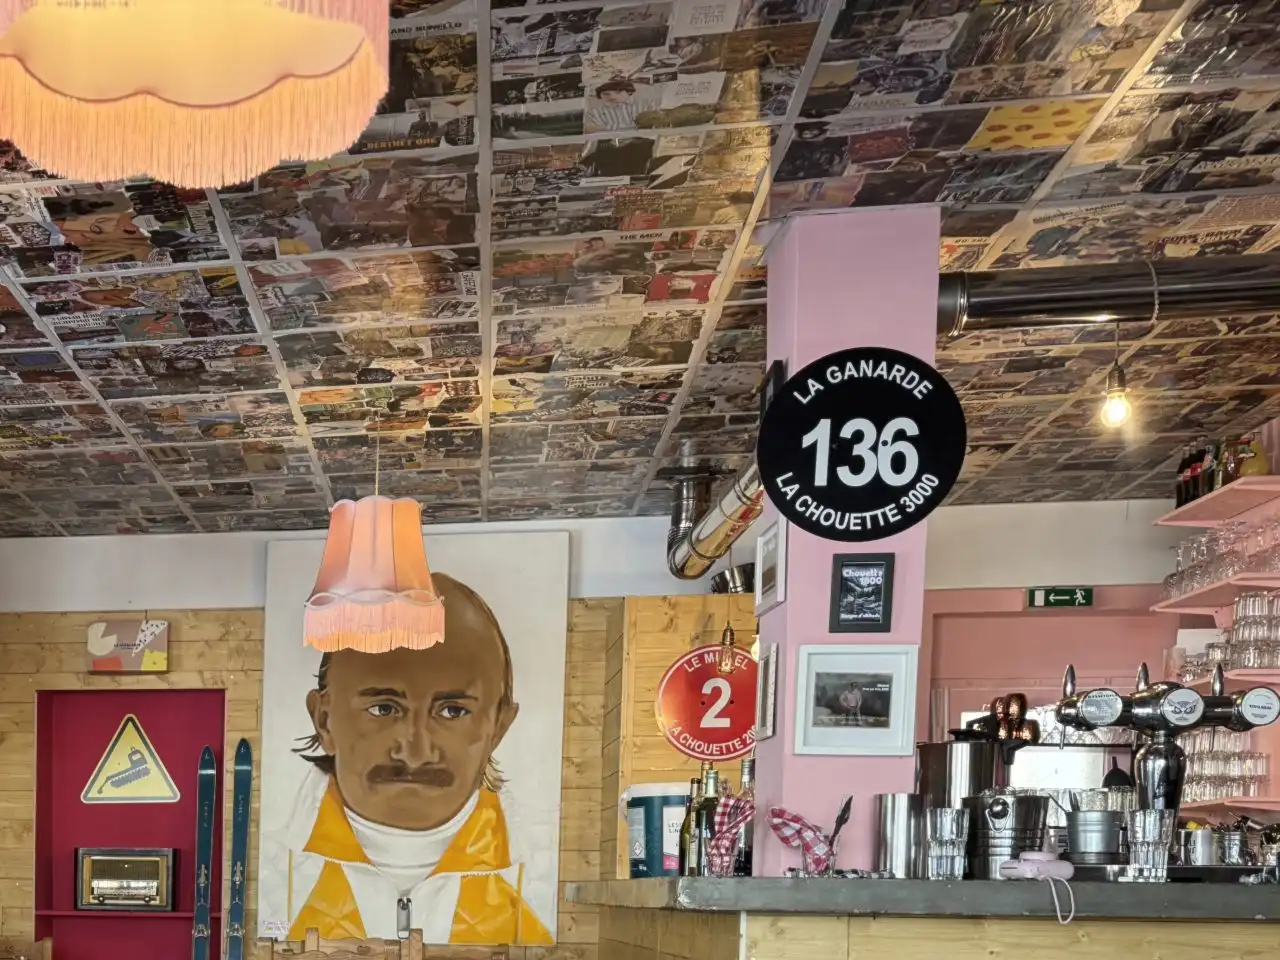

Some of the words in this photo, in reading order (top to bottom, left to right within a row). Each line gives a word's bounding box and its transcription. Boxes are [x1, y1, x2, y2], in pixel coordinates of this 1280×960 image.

[793, 378, 824, 404] LA
[826, 359, 933, 400] GANARDE
[802, 417, 920, 487] 136
[776, 471, 800, 500] LA
[795, 494, 902, 531] CHOUETTE
[900, 472, 940, 513] 3000
[683, 656, 702, 672] LE
[704, 651, 751, 670] MEL
[700, 677, 732, 728] 2
[680, 732, 744, 755] CHOUETTE
